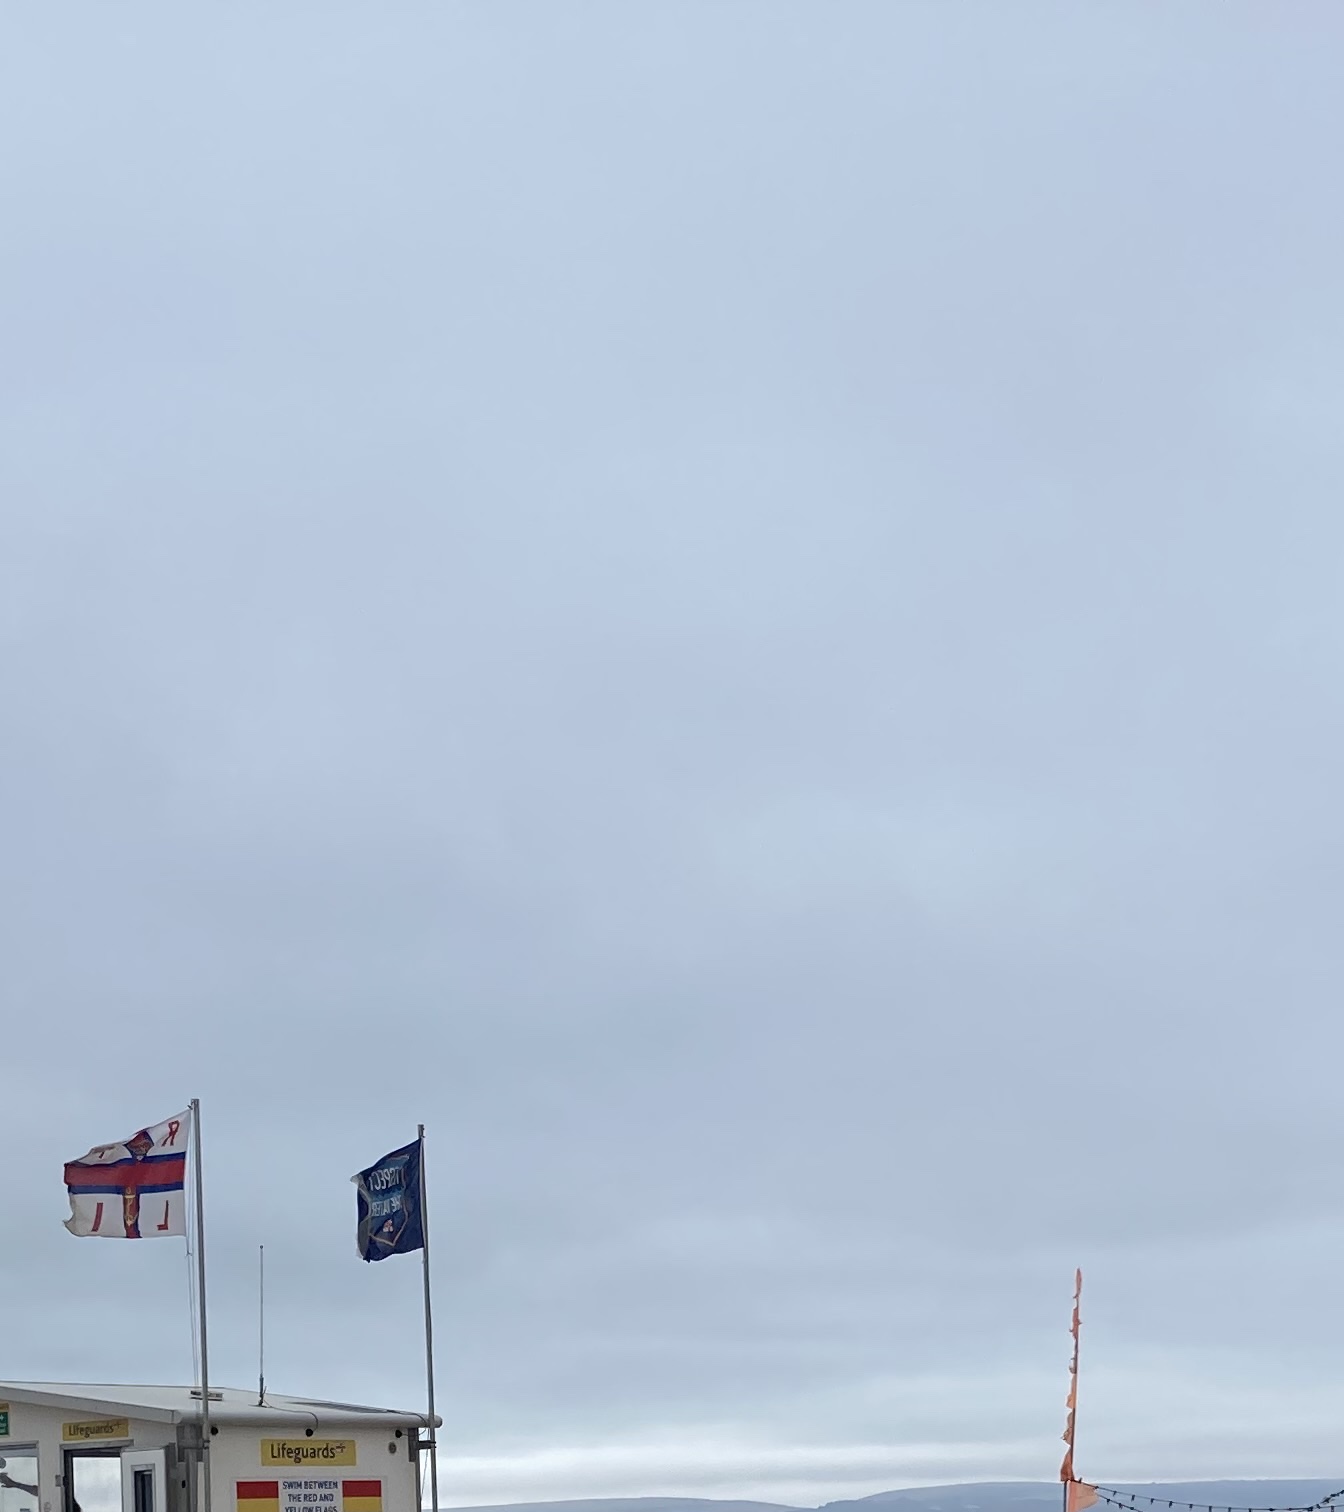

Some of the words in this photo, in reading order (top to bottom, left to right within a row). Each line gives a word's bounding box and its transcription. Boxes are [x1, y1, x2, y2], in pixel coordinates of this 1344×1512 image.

[68, 1423, 114, 1438] Lifeguards
[270, 1443, 336, 1464] Lifeguards
[282, 1480, 303, 1490] SWIM
[304, 1480, 338, 1490] BETWEEN
[287, 1493, 302, 1502] THE
[303, 1493, 318, 1502] RED
[319, 1493, 334, 1501] AND
